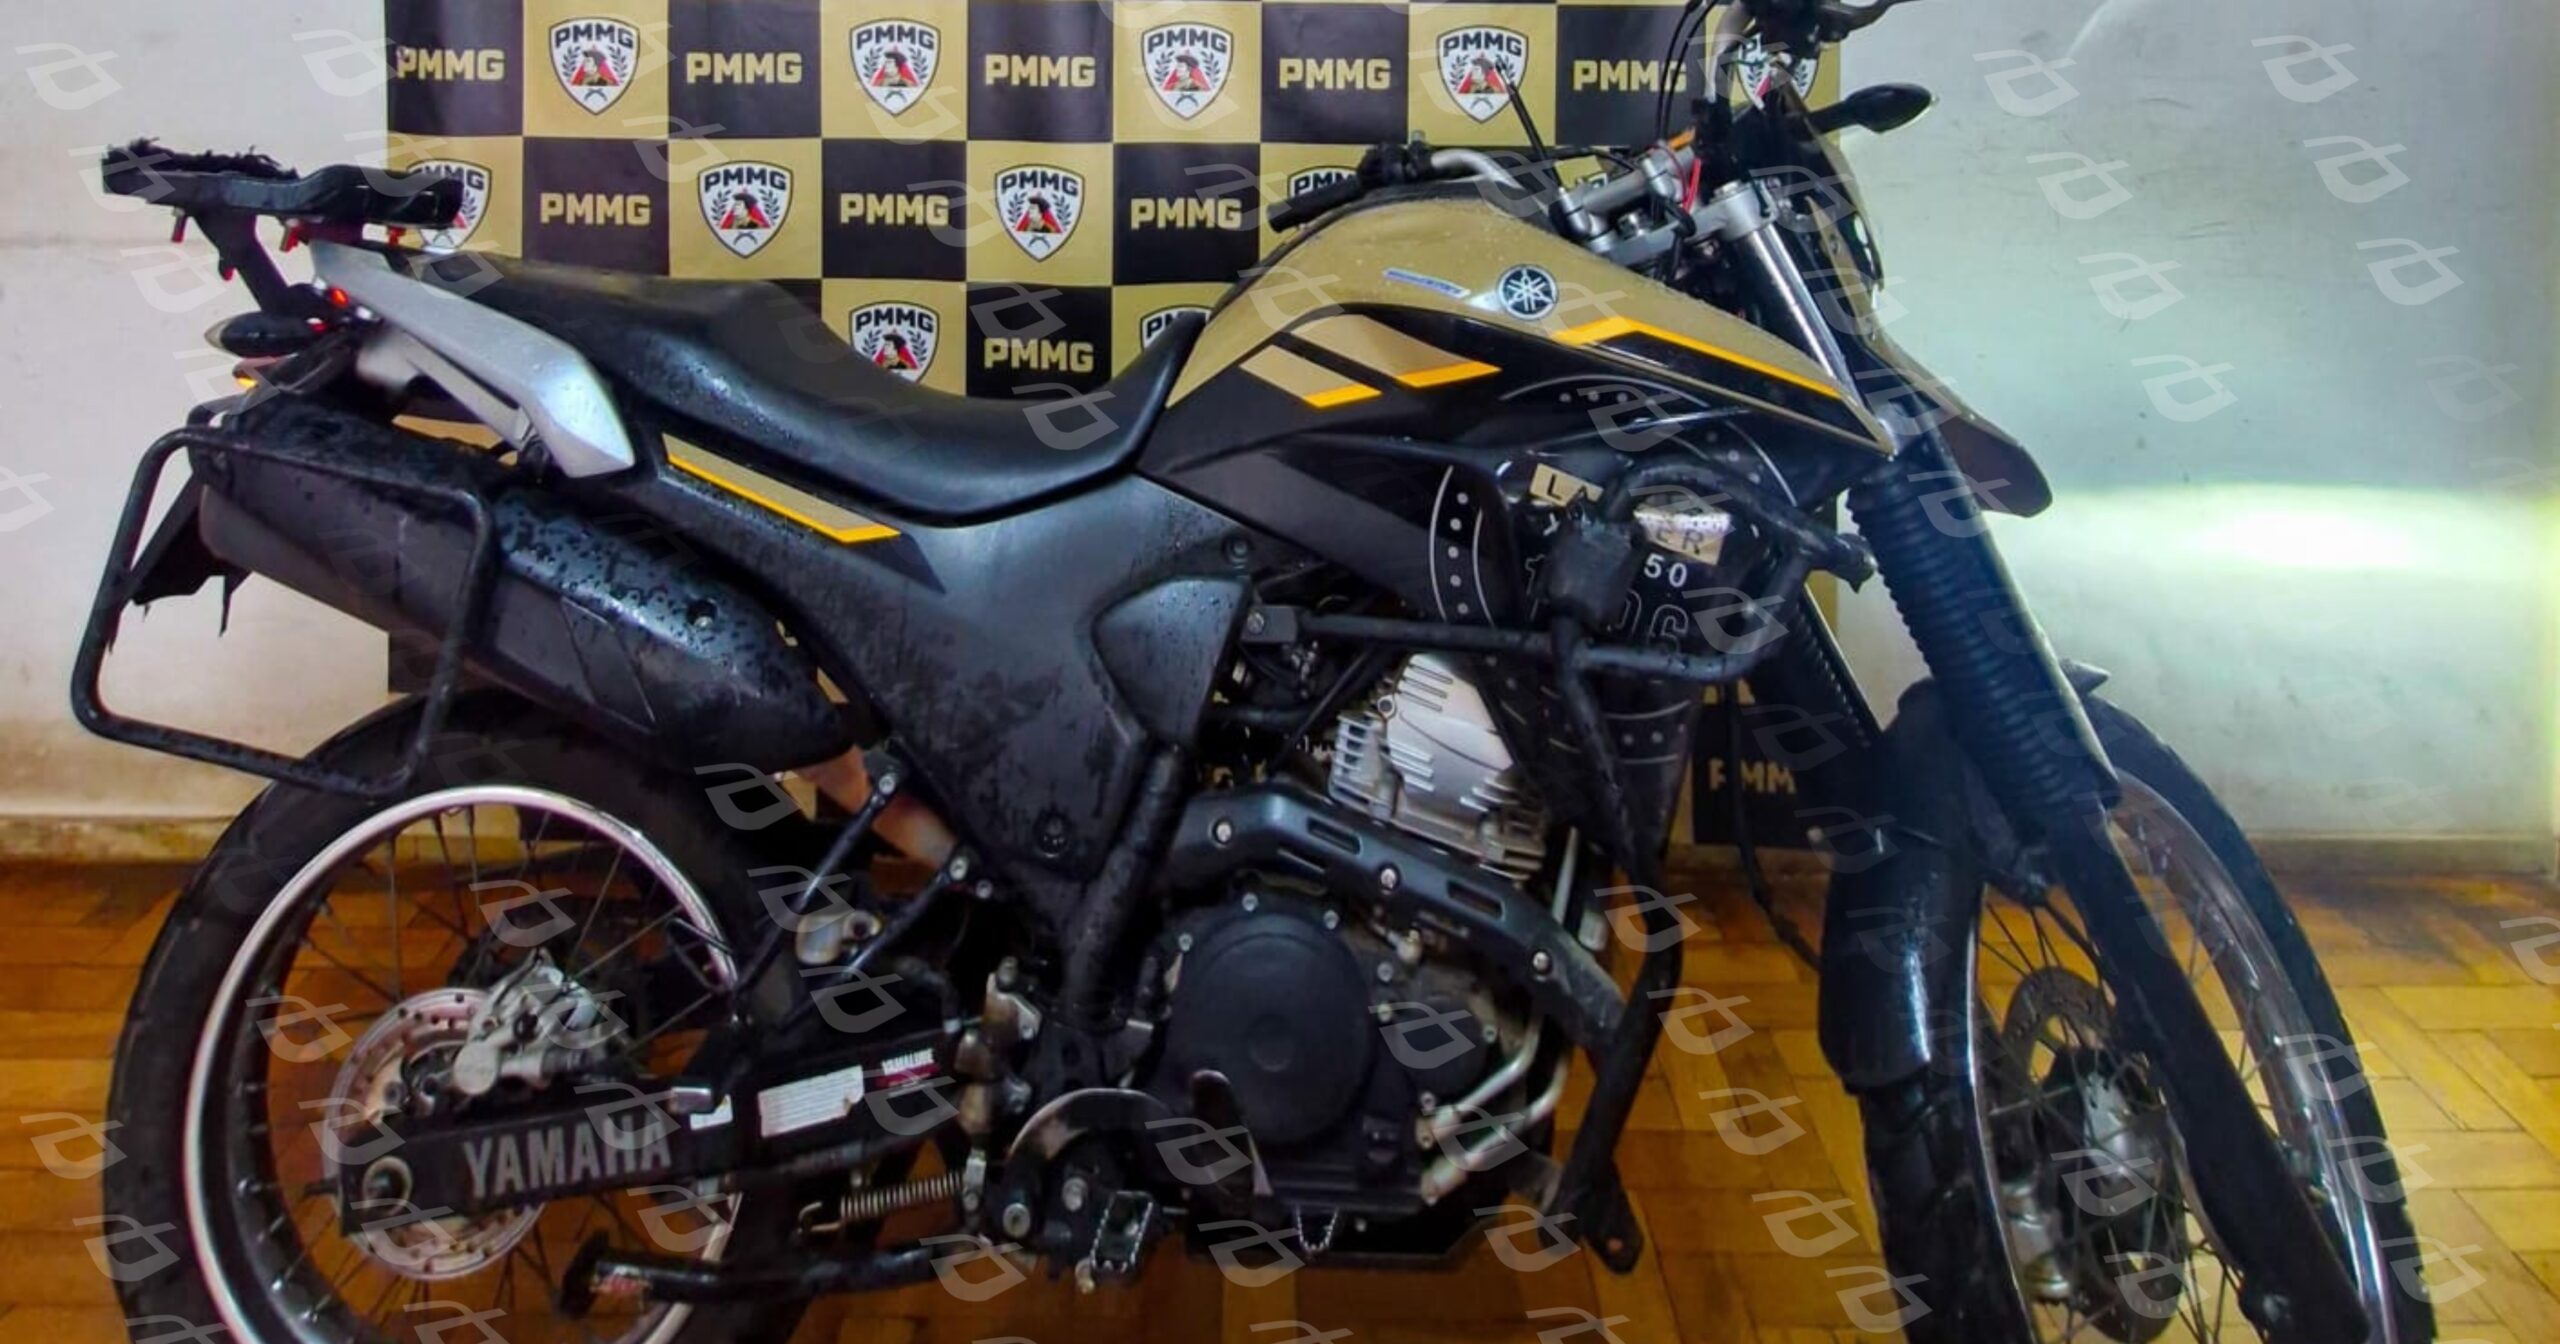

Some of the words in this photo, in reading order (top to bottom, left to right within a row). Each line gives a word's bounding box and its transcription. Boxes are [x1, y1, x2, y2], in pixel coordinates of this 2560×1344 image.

[554, 24, 634, 49] PMMG
[856, 25, 936, 50] PMMG
[1147, 28, 1228, 55] PMMG
[1442, 31, 1522, 56] PMMG
[396, 47, 505, 81] PMMG
[686, 52, 802, 85] PMMG
[985, 54, 1096, 88] PMMG
[1279, 58, 1391, 90] PMMG
[704, 167, 787, 193] PMMG
[1000, 172, 1080, 197] PMMG
[540, 193, 651, 225] PMMG
[839, 194, 949, 226] PMMG
[1131, 197, 1242, 230] PMMG
[855, 307, 934, 332] PMMG
[984, 337, 1094, 373] PMMG
[1643, 553, 1688, 588] 50
[1708, 757, 1797, 795] PMM
[463, 1115, 671, 1198] YAMAHA
